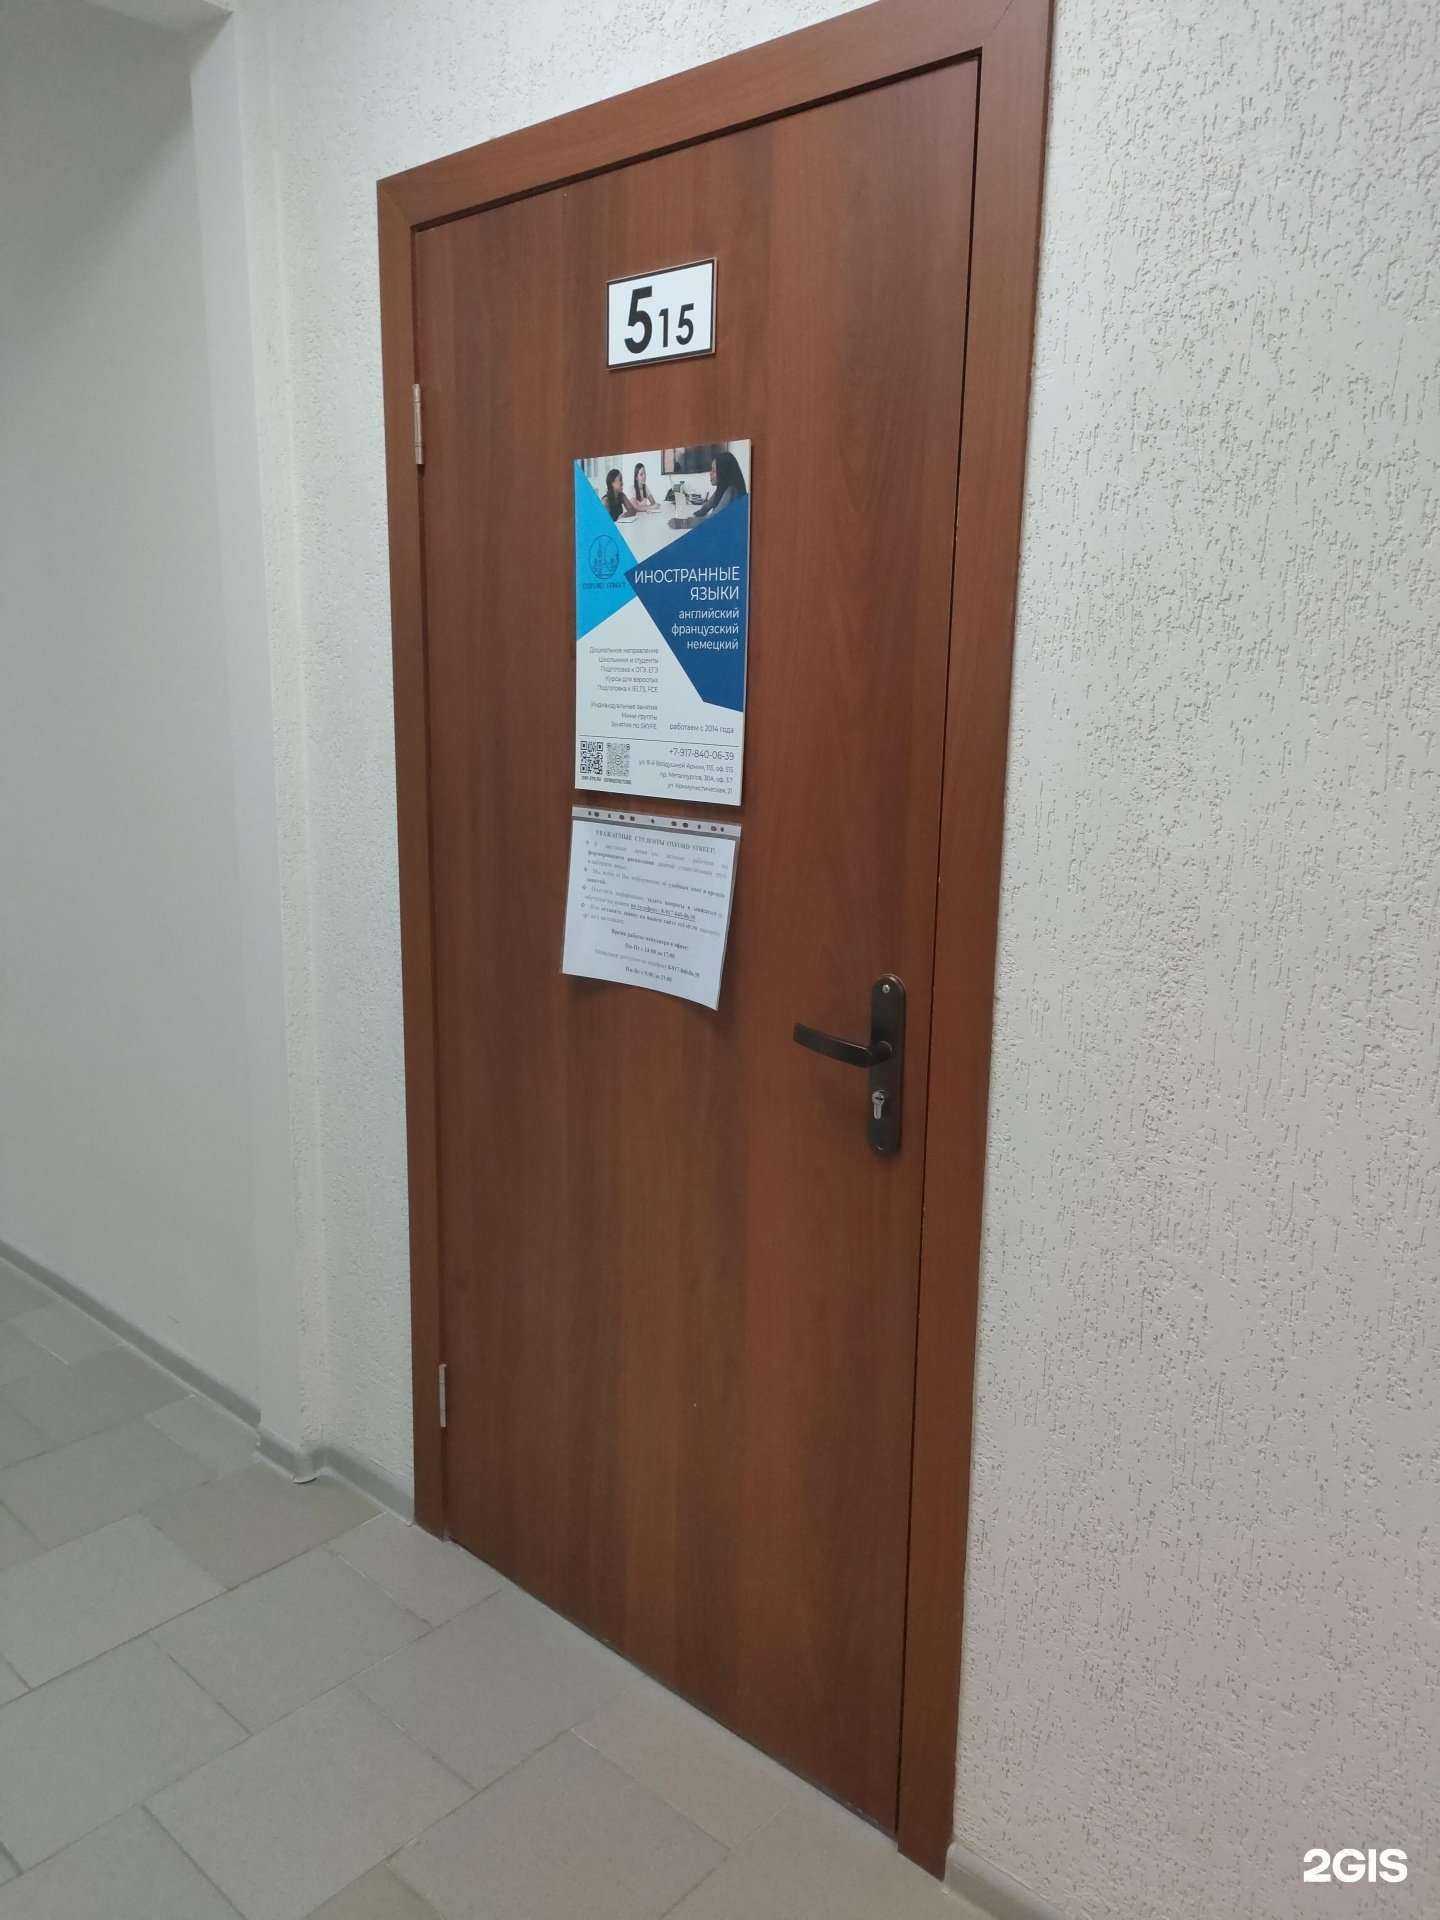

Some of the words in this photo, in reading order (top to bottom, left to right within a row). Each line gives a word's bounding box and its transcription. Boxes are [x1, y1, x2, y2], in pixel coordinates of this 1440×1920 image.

[624, 285, 694, 354] 515
[634, 566, 740, 584] ИНОСТРАННЫЕ
[690, 586, 739, 601] ЯЗЫКИ
[678, 607, 740, 619] английский
[671, 622, 739, 637] французский
[687, 639, 739, 651] немецкий
[669, 723, 699, 732] работаем
[704, 724, 719, 733] 2014
[719, 726, 734, 735] года
[669, 747, 735, 761] +7-917-840-06-39
